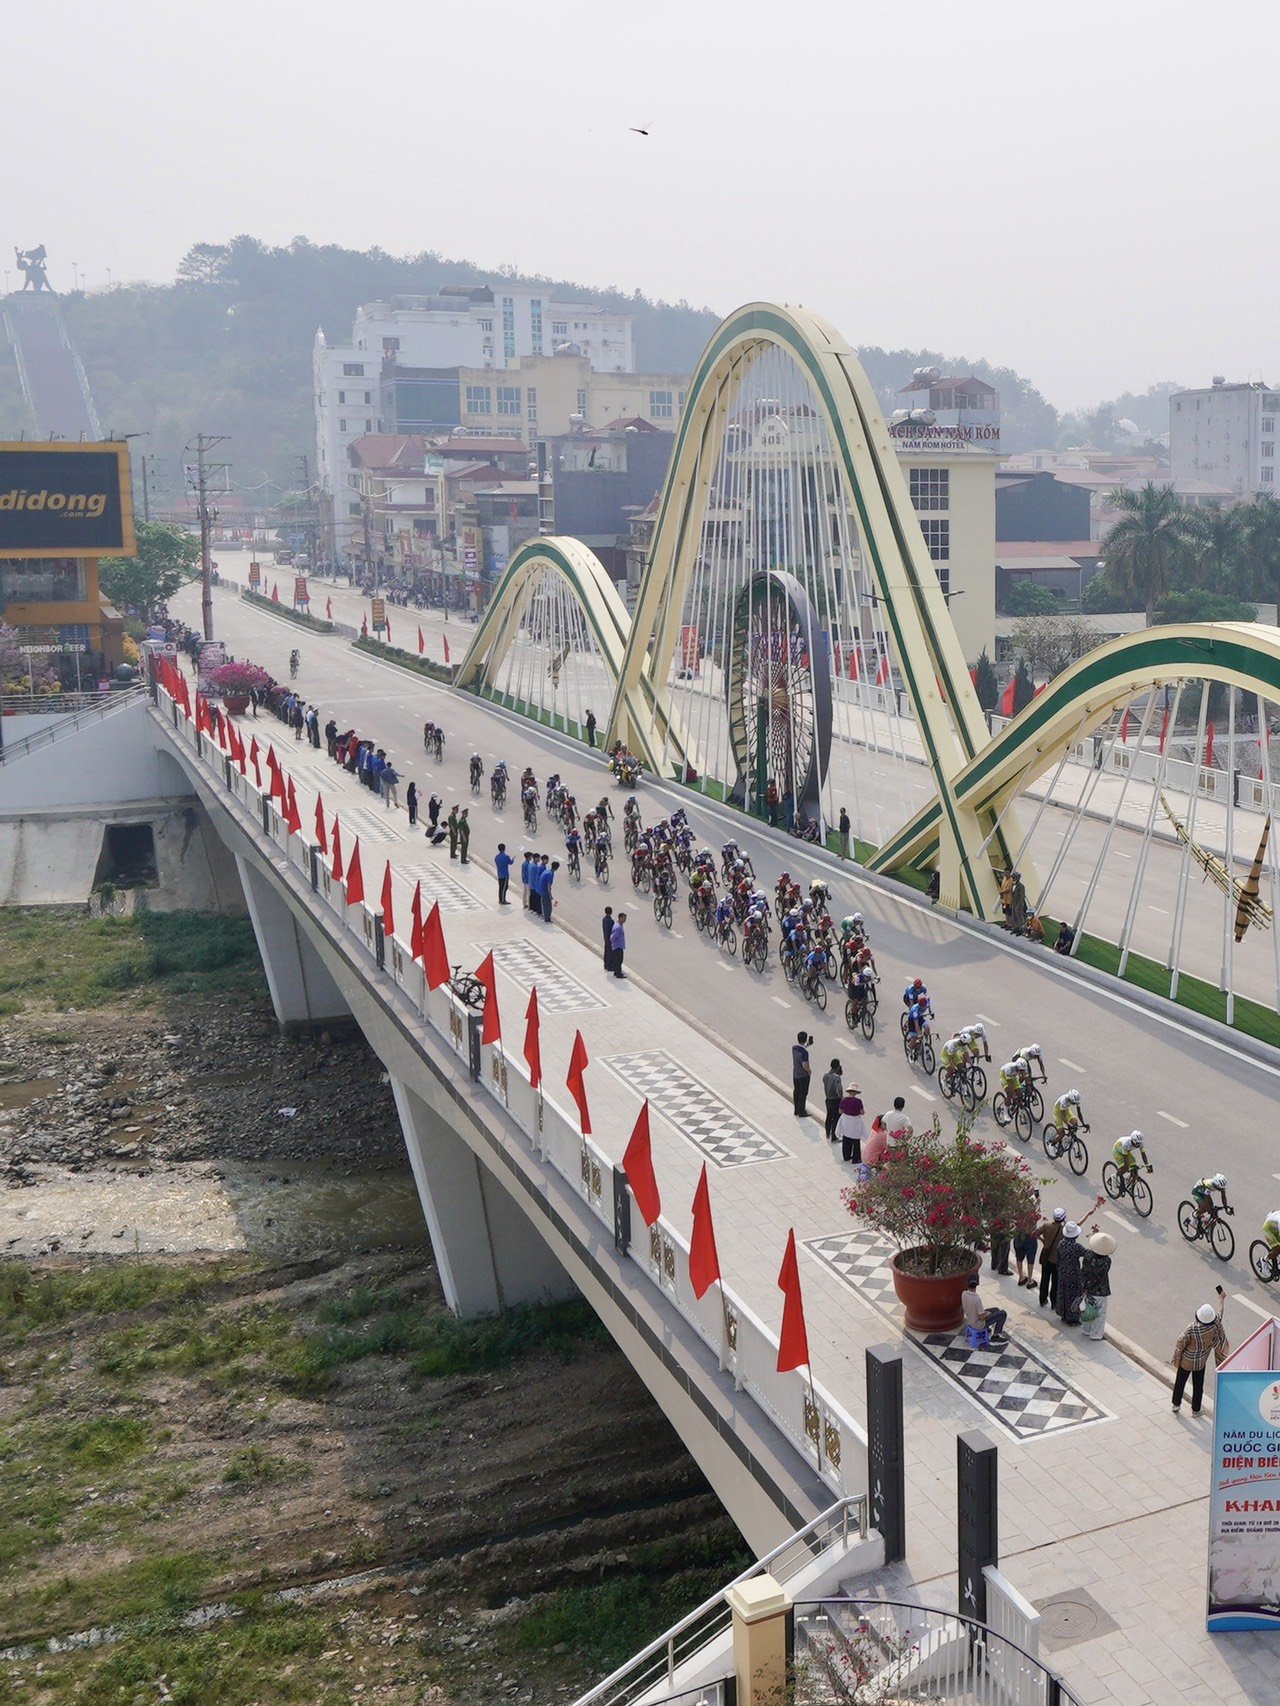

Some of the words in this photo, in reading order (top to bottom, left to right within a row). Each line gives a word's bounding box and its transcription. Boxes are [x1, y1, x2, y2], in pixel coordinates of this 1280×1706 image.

[940, 441, 965, 449] HOTEL
[20, 644, 63, 654] NEIGHBOR
[1223, 1430, 1246, 1439] NĂM
[1248, 1431, 1264, 1439] DU
[1222, 1440, 1263, 1453] QUỐC
[1222, 1455, 1254, 1471] ĐIỆN
